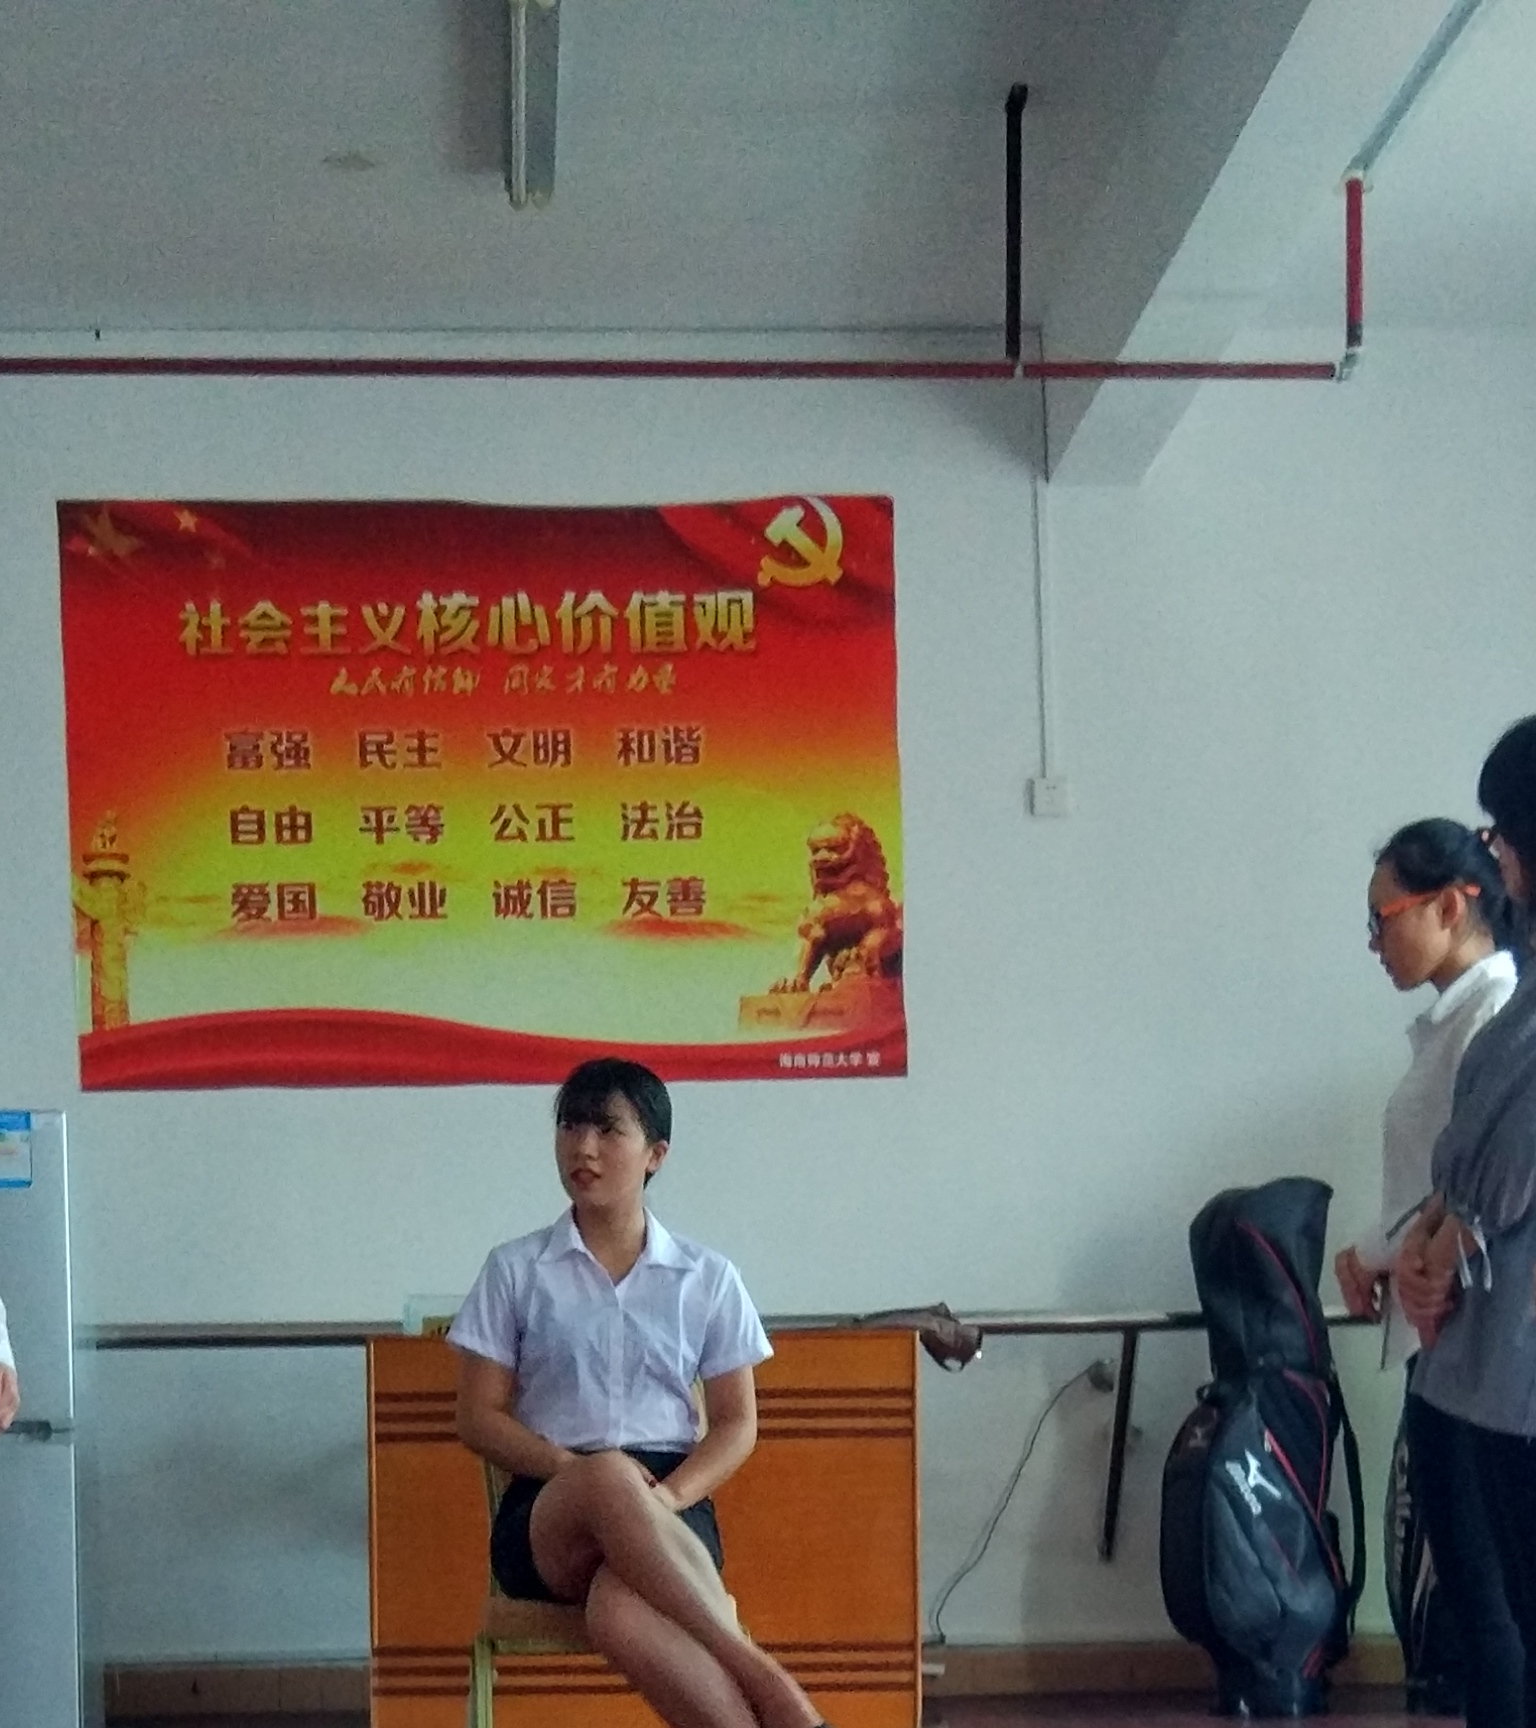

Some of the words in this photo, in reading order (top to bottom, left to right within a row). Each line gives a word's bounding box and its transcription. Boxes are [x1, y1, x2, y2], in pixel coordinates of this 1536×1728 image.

[178, 590, 757, 656] 社会主义核心价值观
[224, 729, 312, 770] 富强
[358, 729, 442, 770] 民主
[486, 727, 572, 768] 文明
[617, 726, 703, 767] 和谐
[229, 804, 313, 845] 自由
[358, 804, 444, 845] 平等
[489, 802, 576, 843] 公正
[620, 800, 704, 842] 法治
[230, 881, 317, 922] 爱国
[361, 880, 448, 921] 敬业
[492, 878, 577, 920] 诚信
[622, 876, 707, 919] 友善
